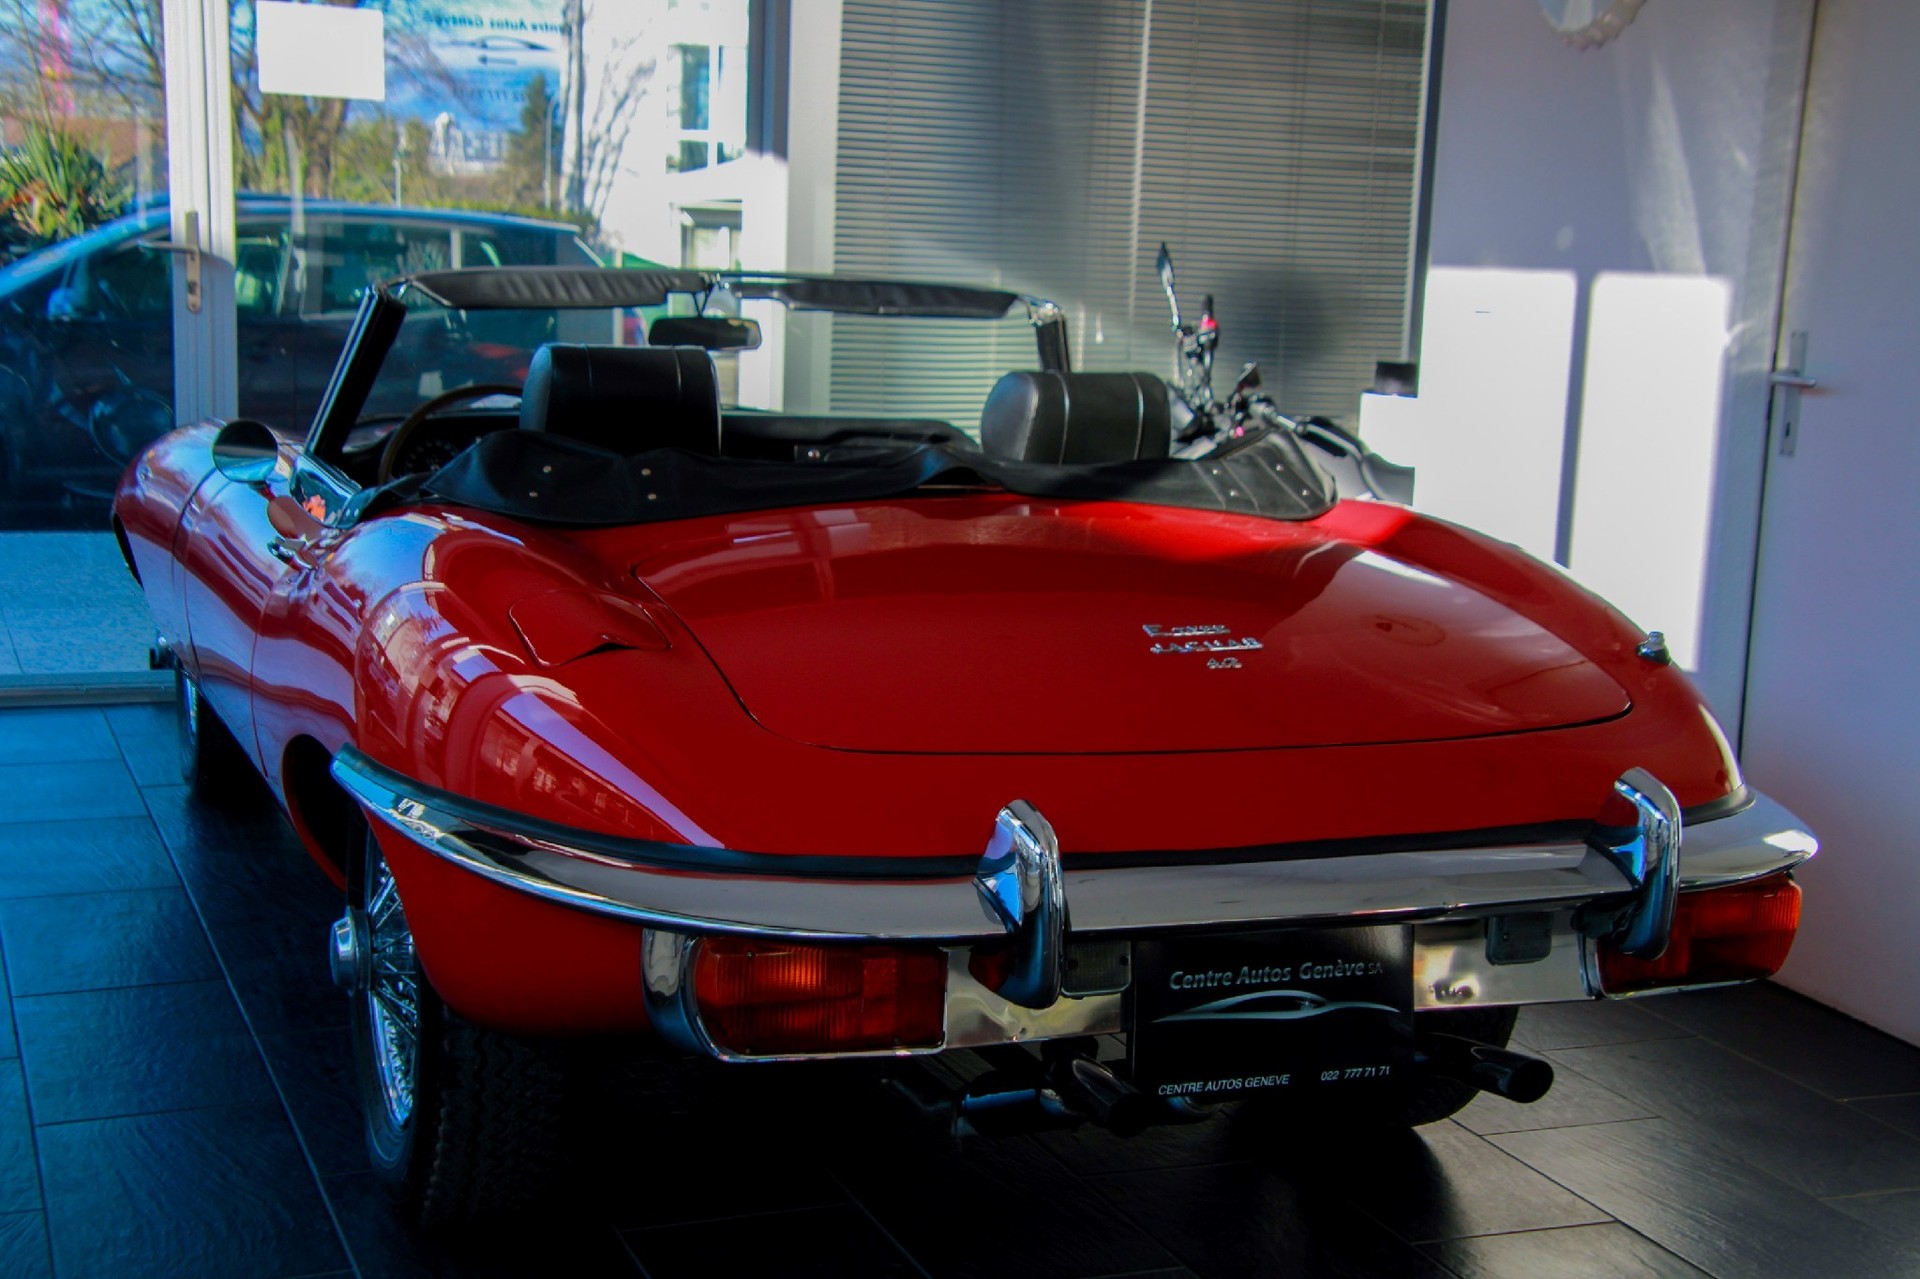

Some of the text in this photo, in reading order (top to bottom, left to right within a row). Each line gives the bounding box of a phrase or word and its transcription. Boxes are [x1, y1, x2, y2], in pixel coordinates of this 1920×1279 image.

[1169, 971, 1233, 990] Centre
[1236, 966, 1291, 984] Autos
[1300, 959, 1365, 980] Genève
[1321, 1066, 1390, 1081] 022 777 71 71
[1158, 1074, 1290, 1095] CENTRE AUTOS GENEVE
